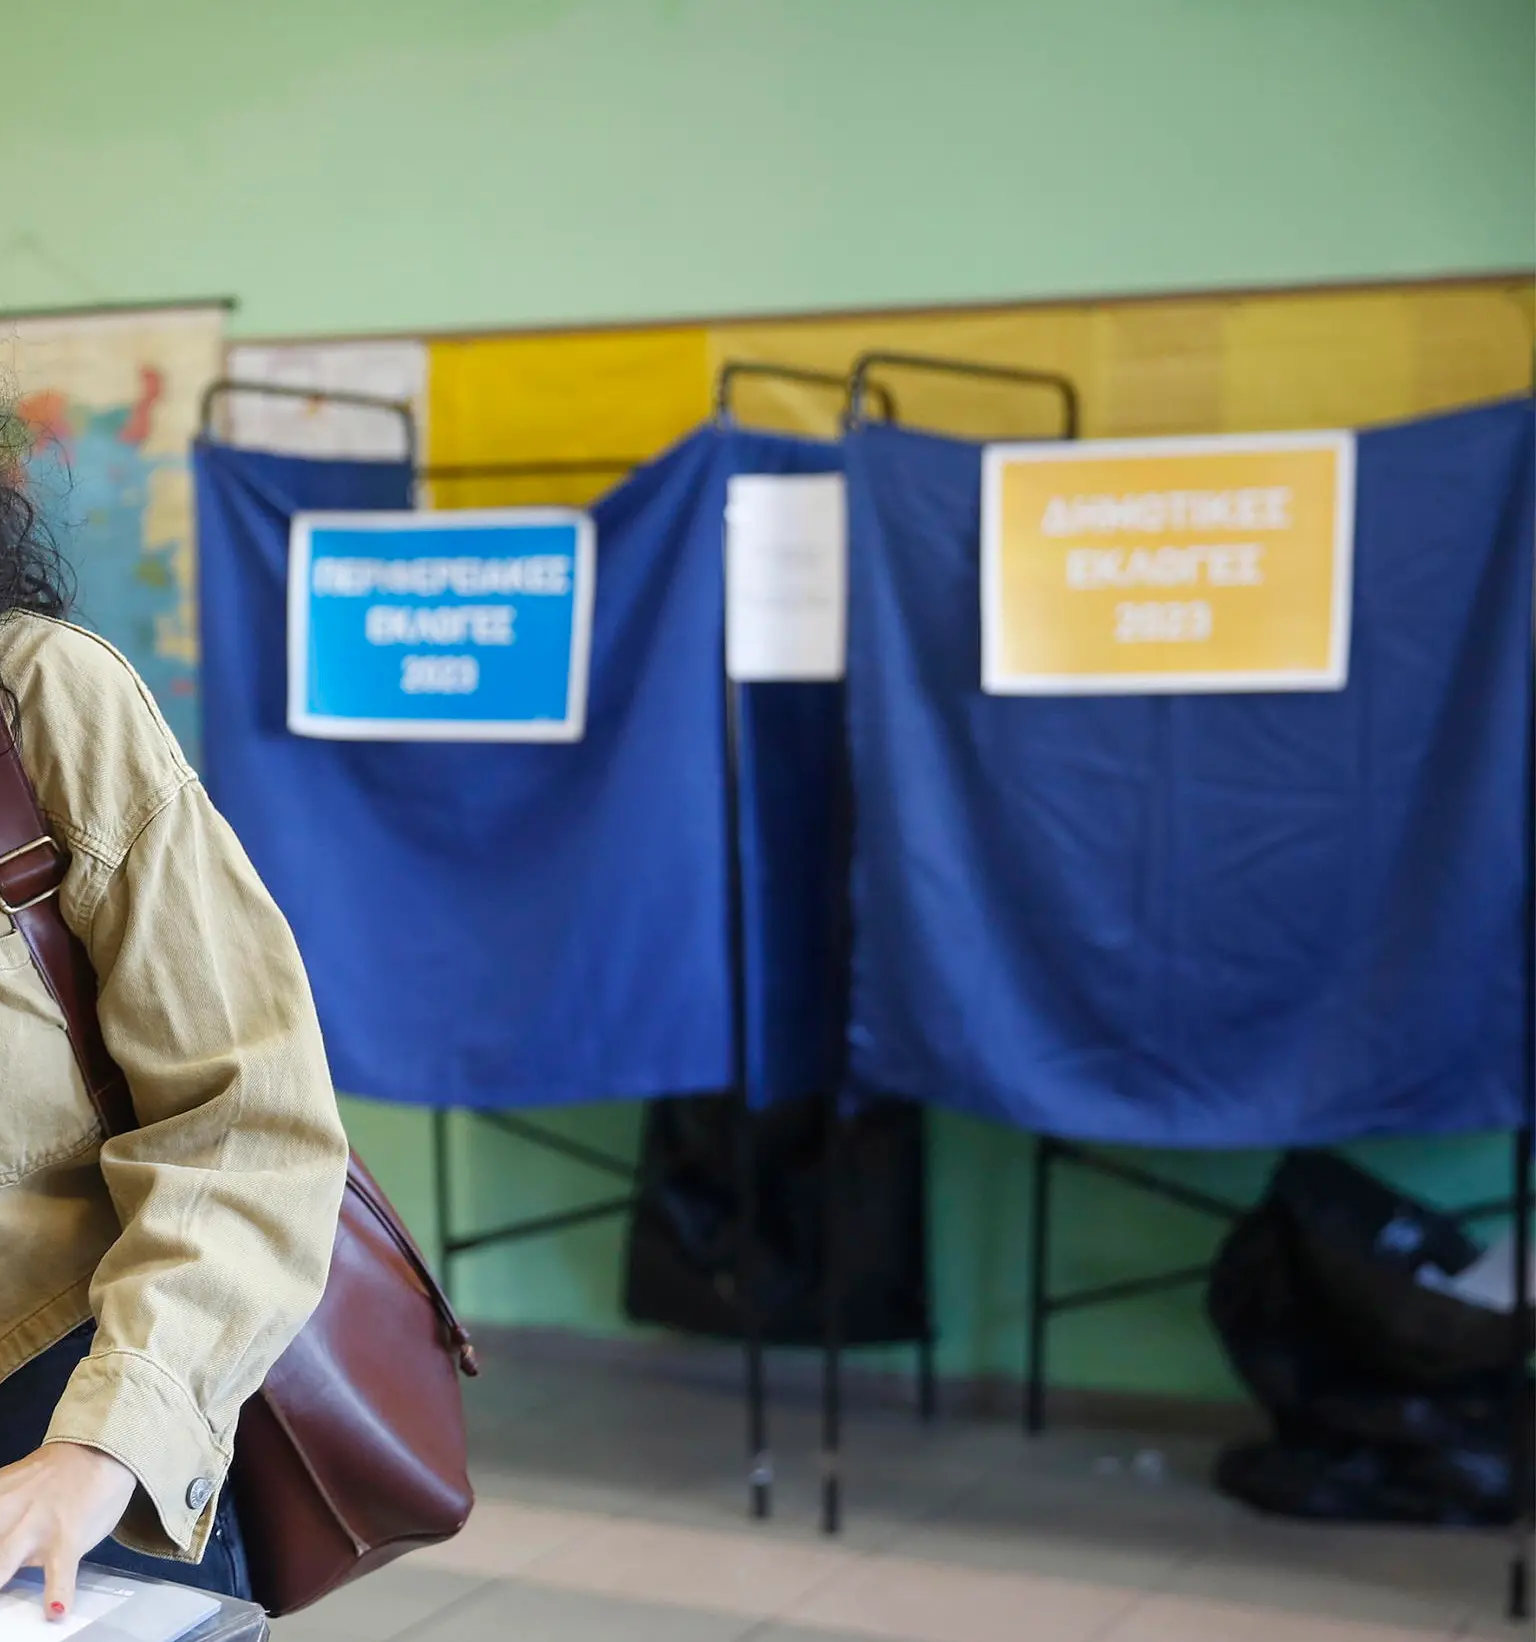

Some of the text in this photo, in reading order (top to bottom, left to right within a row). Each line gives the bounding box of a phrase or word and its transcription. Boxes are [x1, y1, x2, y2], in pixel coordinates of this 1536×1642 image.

[1041, 487, 1290, 536] ΔΗΜΟΤΙΚΕΣ
[1066, 543, 1263, 589] ΕΚΛΟΓΕΣ
[366, 605, 514, 644] ΕΚΛΟΓΕΣ
[1114, 600, 1212, 642] 2023
[401, 655, 478, 693] 2023
